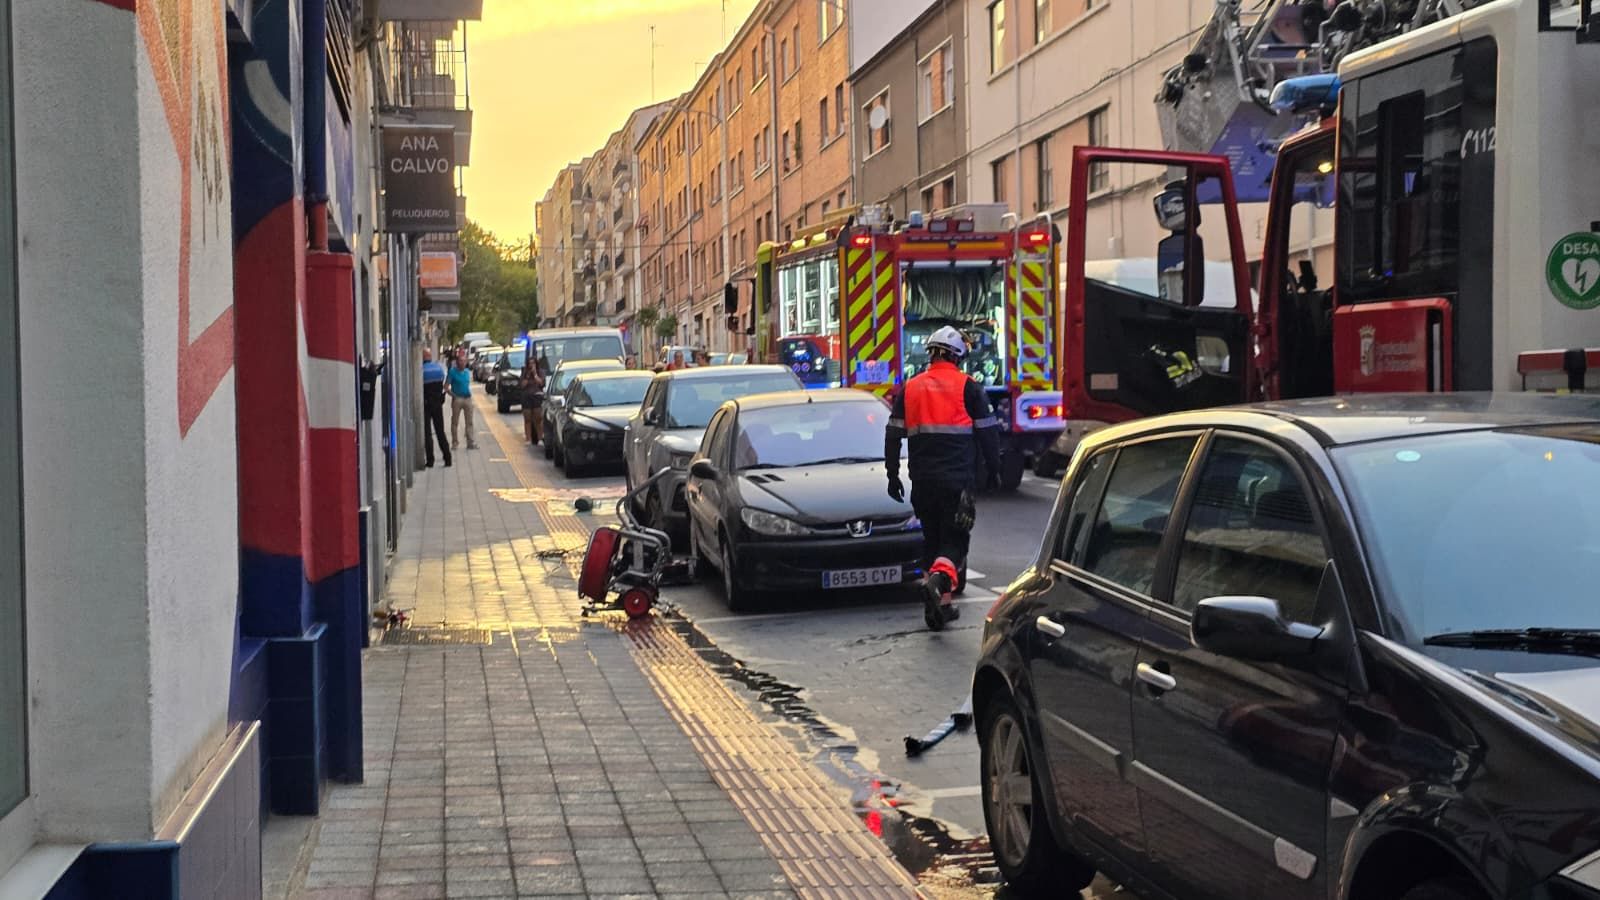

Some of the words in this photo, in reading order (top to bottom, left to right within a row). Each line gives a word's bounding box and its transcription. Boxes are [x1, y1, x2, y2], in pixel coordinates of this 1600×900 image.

[400, 135, 439, 151] ANA
[1472, 127, 1497, 154] 112
[391, 157, 449, 173] CALVO
[392, 208, 450, 218] PELUQUEROS
[1563, 242, 1600, 255] DESA
[832, 571, 867, 586] 8553
[871, 568, 898, 583] CYP
